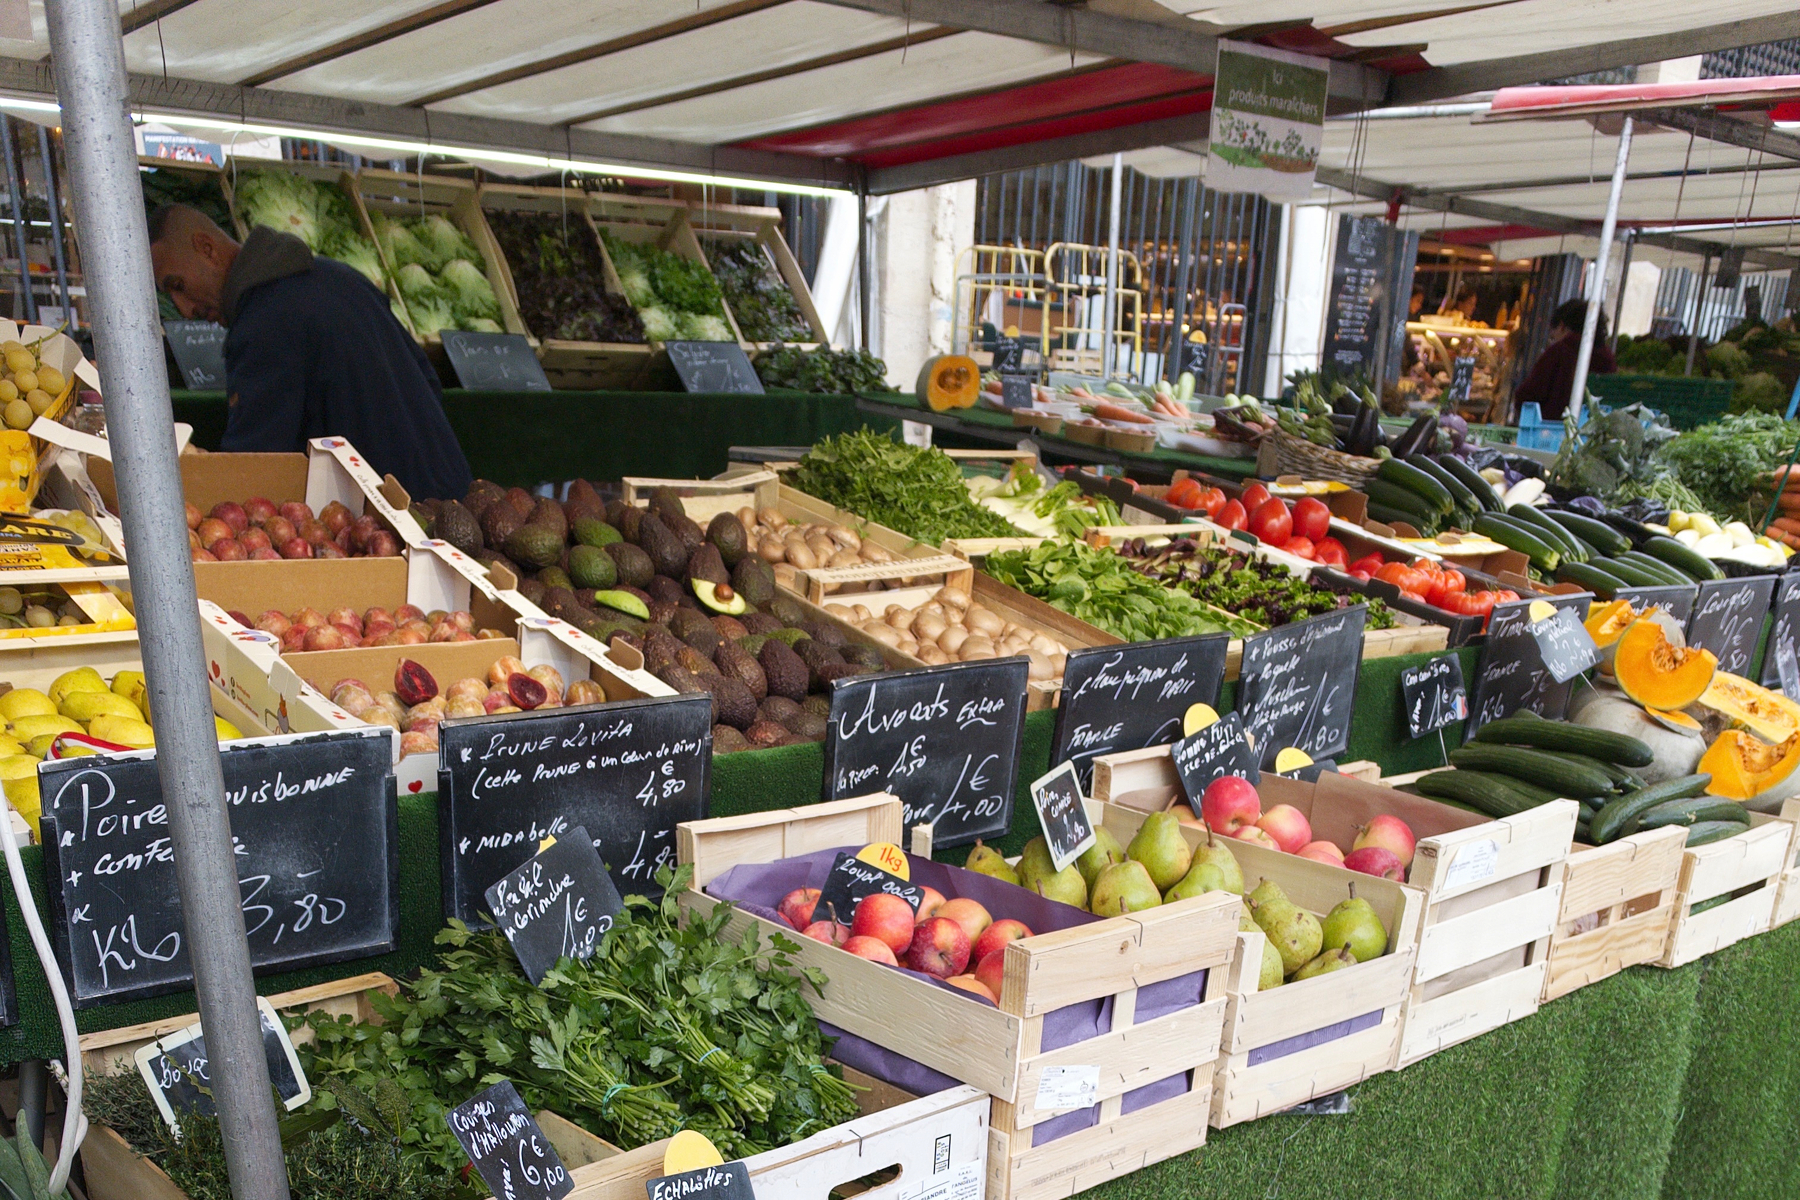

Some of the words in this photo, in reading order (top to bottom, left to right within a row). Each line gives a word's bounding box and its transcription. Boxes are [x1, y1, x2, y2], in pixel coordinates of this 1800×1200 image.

[838, 682, 950, 740] Avocats
[635, 770, 687, 807] 4,80
[835, 858, 884, 888] Royal
